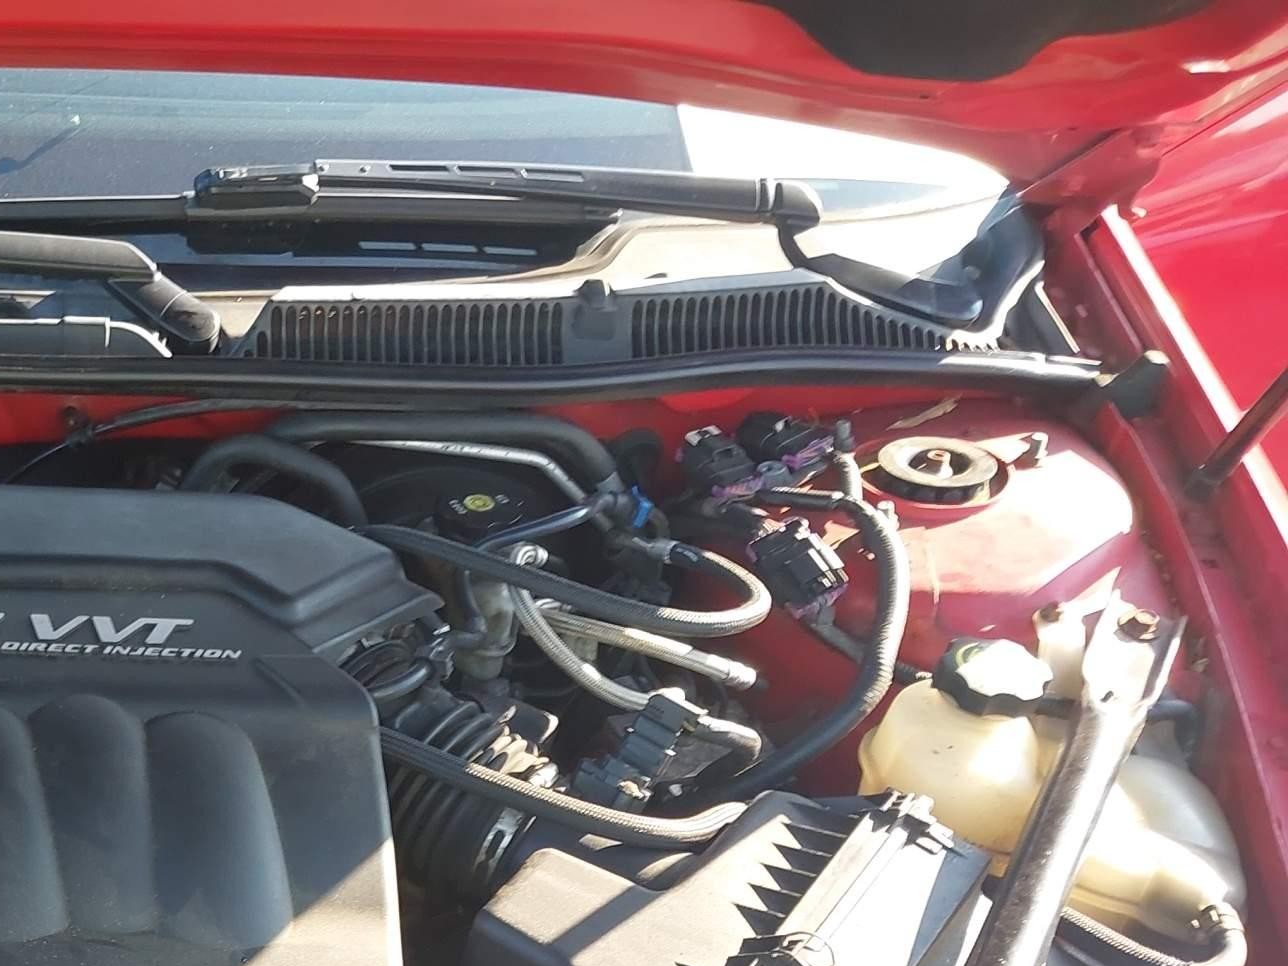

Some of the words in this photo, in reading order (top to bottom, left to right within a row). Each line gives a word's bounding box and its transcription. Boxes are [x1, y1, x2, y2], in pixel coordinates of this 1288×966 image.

[30, 613, 195, 644] VVT
[0, 640, 100, 655] DIRECT
[103, 646, 242, 660] INJECTION
